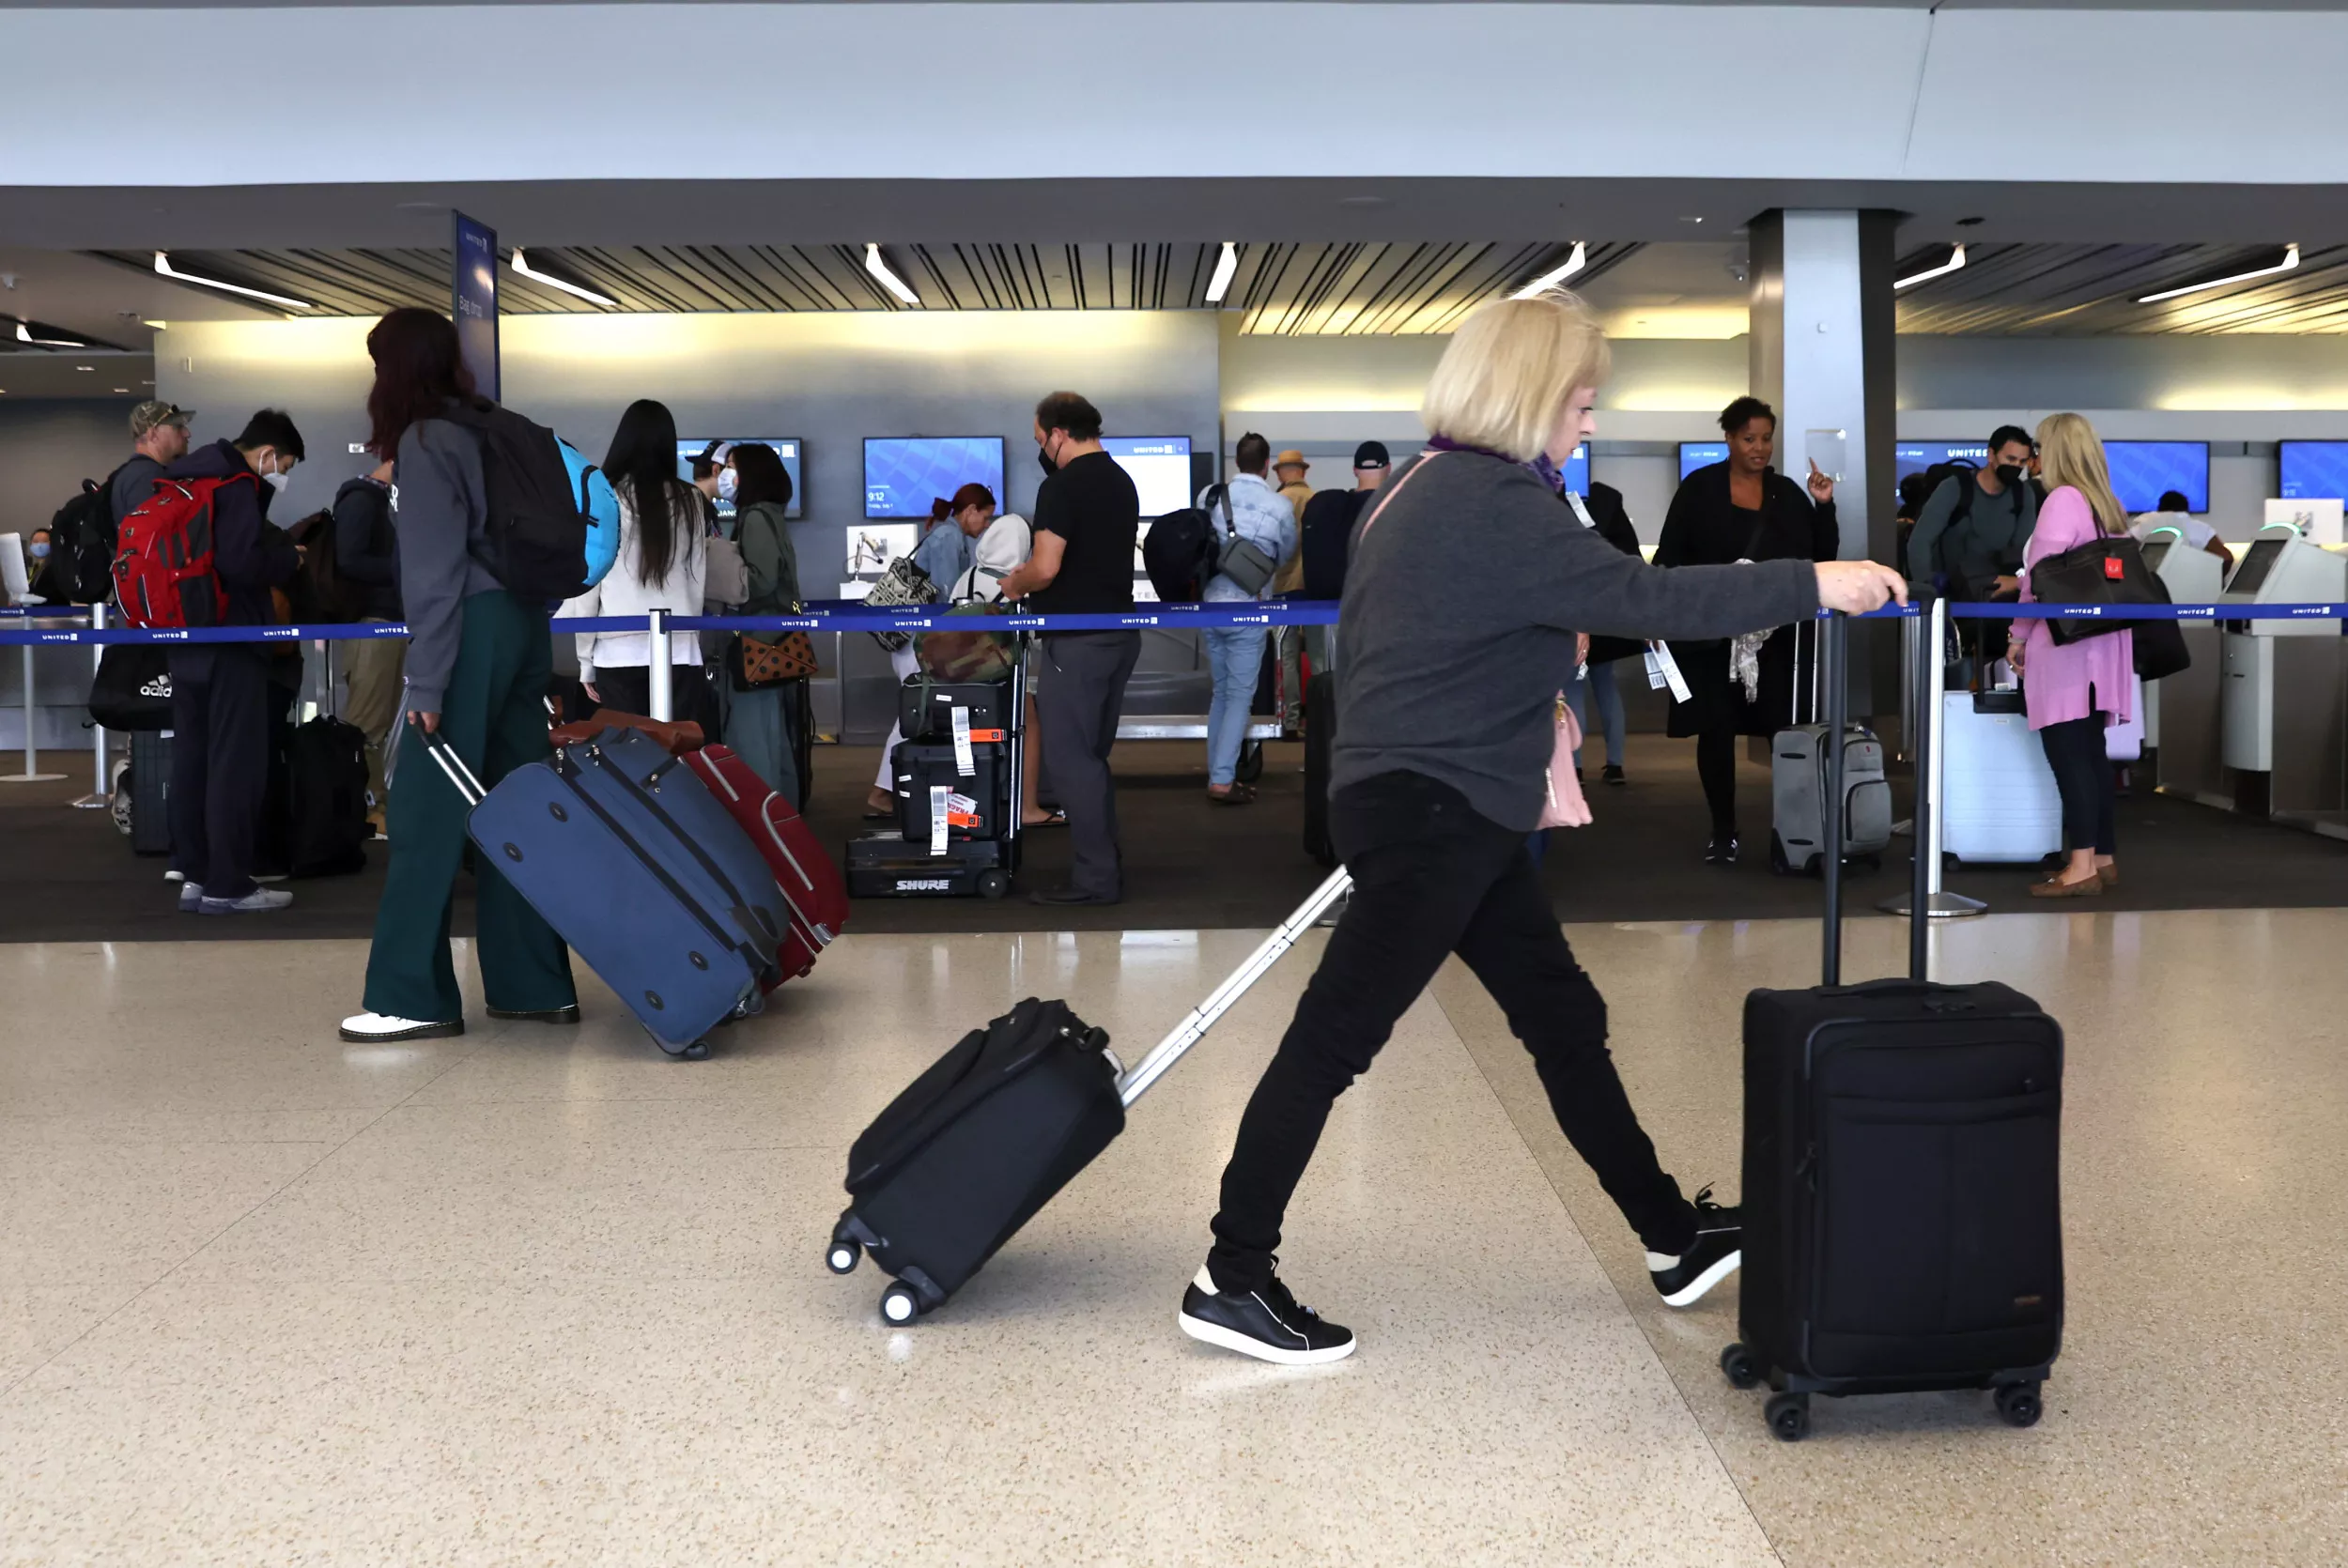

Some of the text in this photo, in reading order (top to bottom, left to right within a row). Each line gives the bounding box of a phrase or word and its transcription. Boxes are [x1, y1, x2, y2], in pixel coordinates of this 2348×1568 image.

[460, 295, 470, 315] Bag
[139, 684, 172, 698] adid
[896, 879, 950, 891] SHURE
